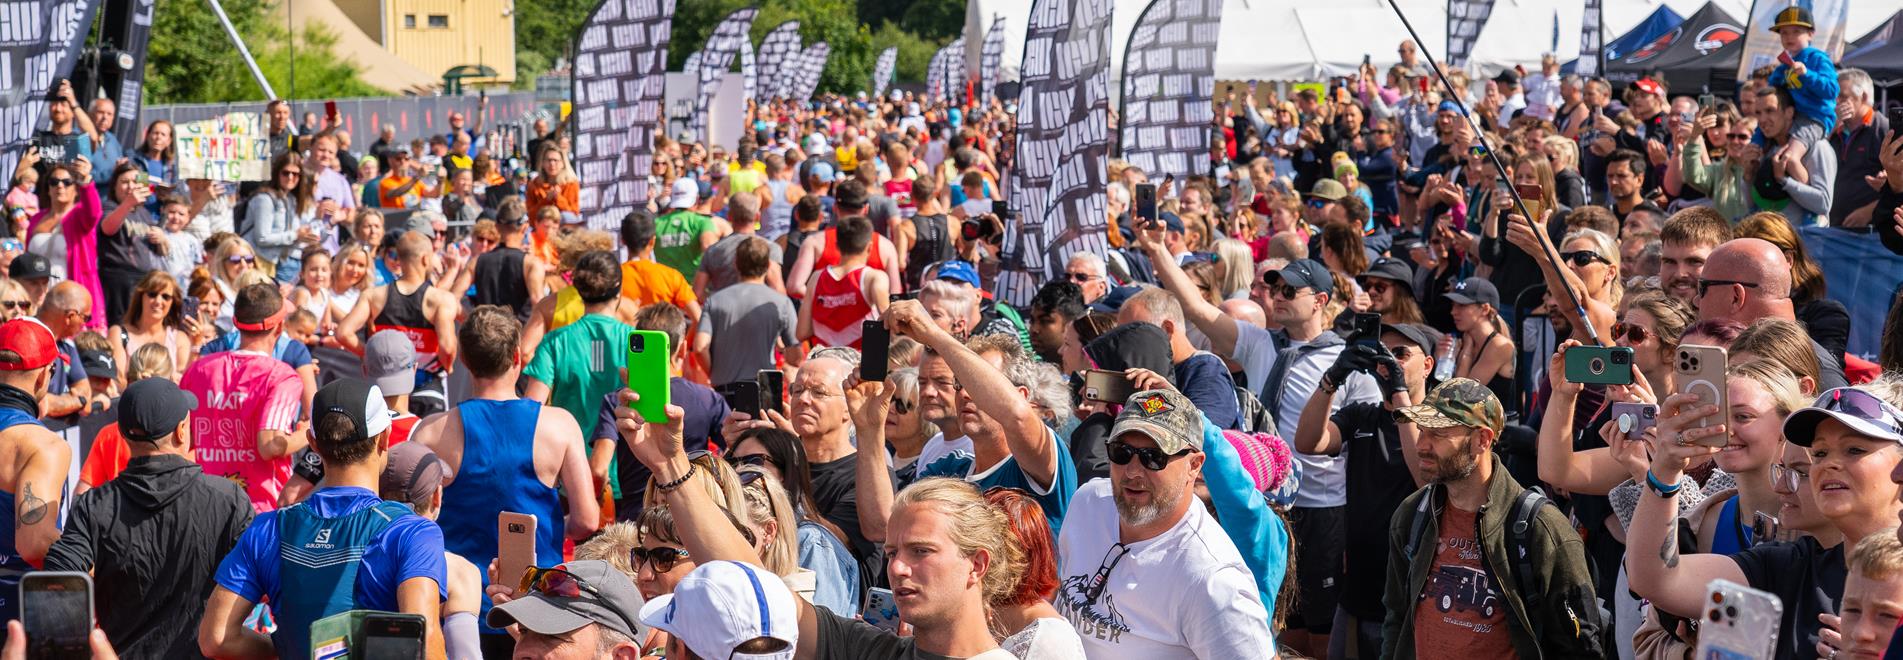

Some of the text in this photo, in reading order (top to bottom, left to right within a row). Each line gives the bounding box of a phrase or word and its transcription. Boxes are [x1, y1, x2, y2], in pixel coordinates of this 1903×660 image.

[180, 137, 218, 158] TEAM
[206, 389, 249, 410] MATT
[304, 542, 335, 550] salomon
